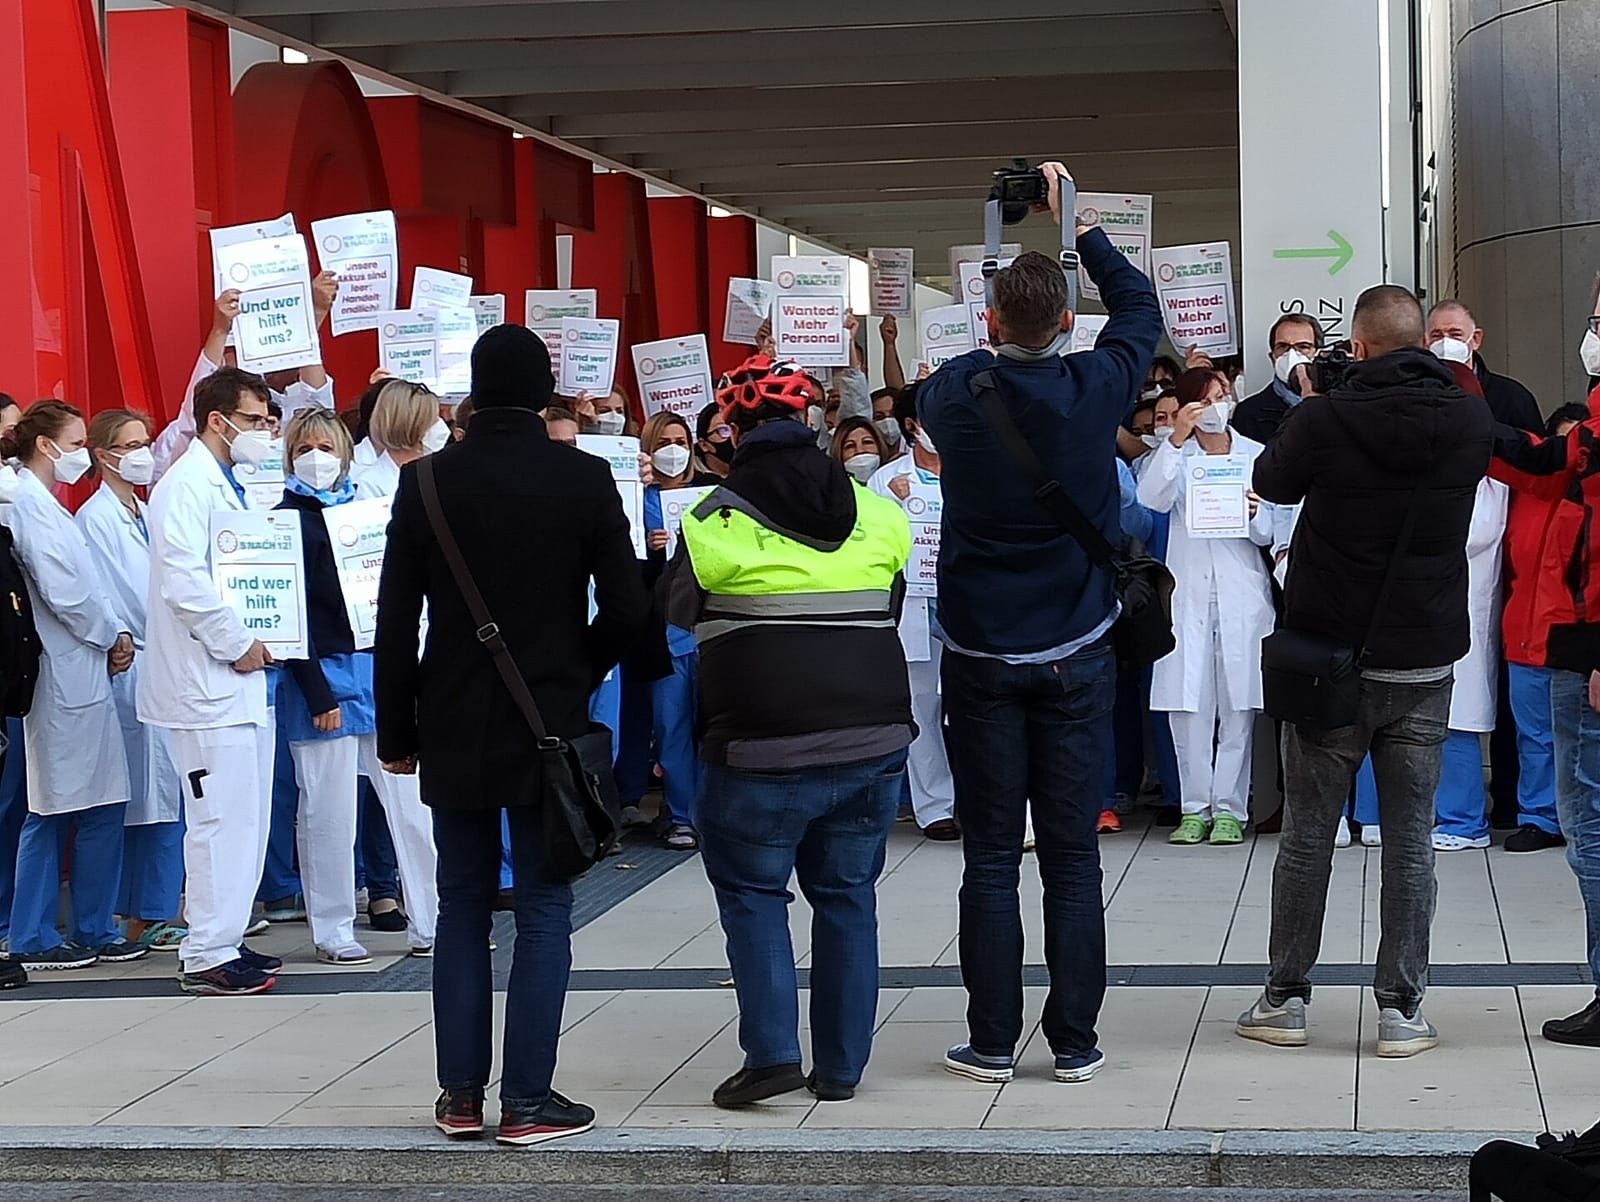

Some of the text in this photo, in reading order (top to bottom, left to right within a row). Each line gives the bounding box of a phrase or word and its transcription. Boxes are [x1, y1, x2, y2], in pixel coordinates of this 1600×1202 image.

[345, 261, 378, 271] Unsere
[367, 270, 387, 280] sind
[240, 296, 301, 314] Und wer
[1166, 294, 1223, 309] Wanted:
[782, 306, 839, 316] Wanted:
[1178, 311, 1212, 323] Mehr
[258, 313, 288, 329] hilft
[793, 319, 828, 329] Mehr
[1171, 322, 1226, 337] Personal
[258, 329, 293, 346] uns?
[781, 333, 840, 343] Personal
[389, 349, 410, 359] Und
[568, 353, 589, 362] Und
[578, 364, 598, 372] hilft
[575, 375, 599, 383] uns?
[649, 384, 703, 401] Wanted:
[661, 400, 693, 412] Mehr
[362, 558, 383, 569] Uns
[227, 576, 292, 590] Und wer
[246, 594, 277, 609] hilft
[244, 614, 281, 628] uns?
